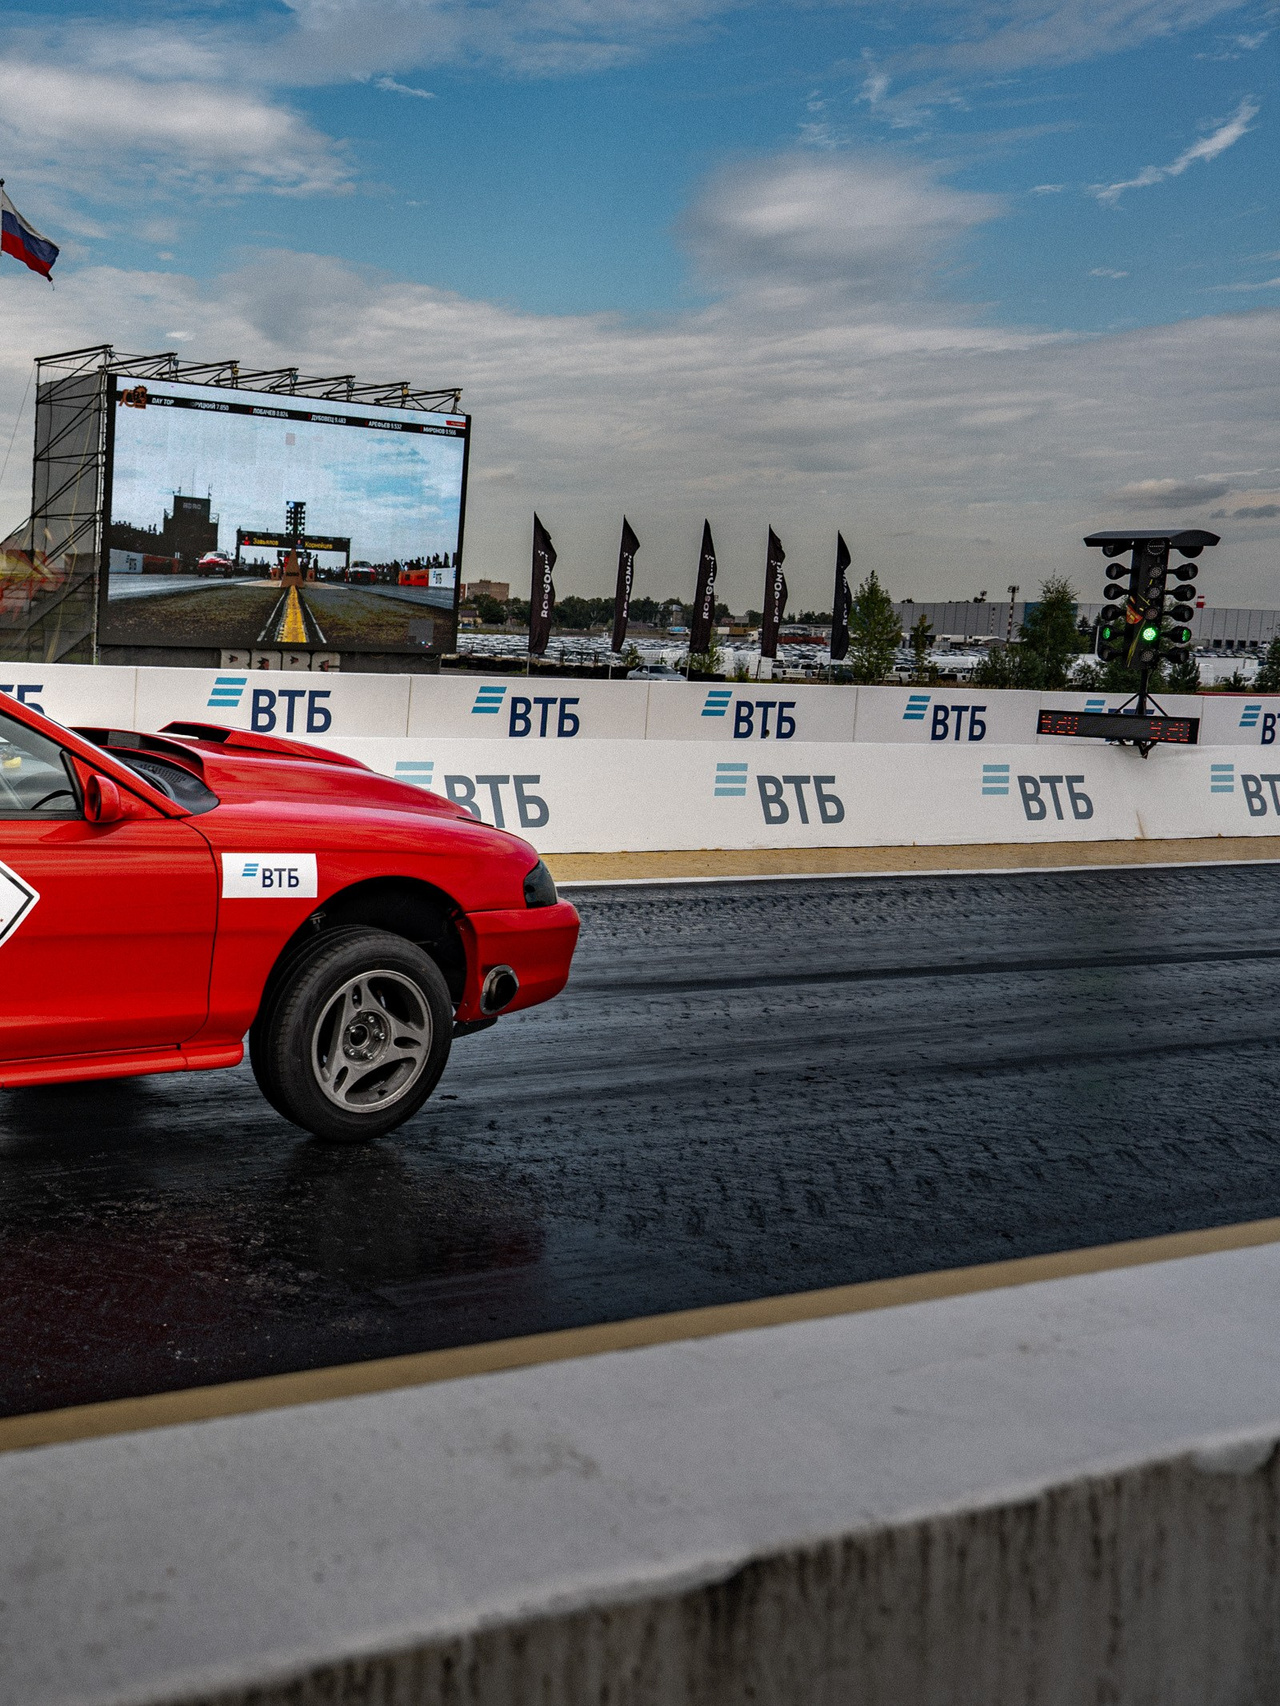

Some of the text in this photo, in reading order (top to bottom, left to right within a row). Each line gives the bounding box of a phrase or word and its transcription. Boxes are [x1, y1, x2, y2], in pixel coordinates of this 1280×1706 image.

[251, 688, 332, 733] ВТБ
[509, 696, 580, 738] ВТБ
[733, 700, 797, 739] ВТБ
[930, 704, 987, 742] ВТБ
[444, 775, 549, 828] ВТБ
[756, 775, 845, 825] ВТБ
[1017, 775, 1094, 821] ВТБ
[1240, 774, 1280, 817] ВТ
[261, 867, 300, 888] ВТБ
